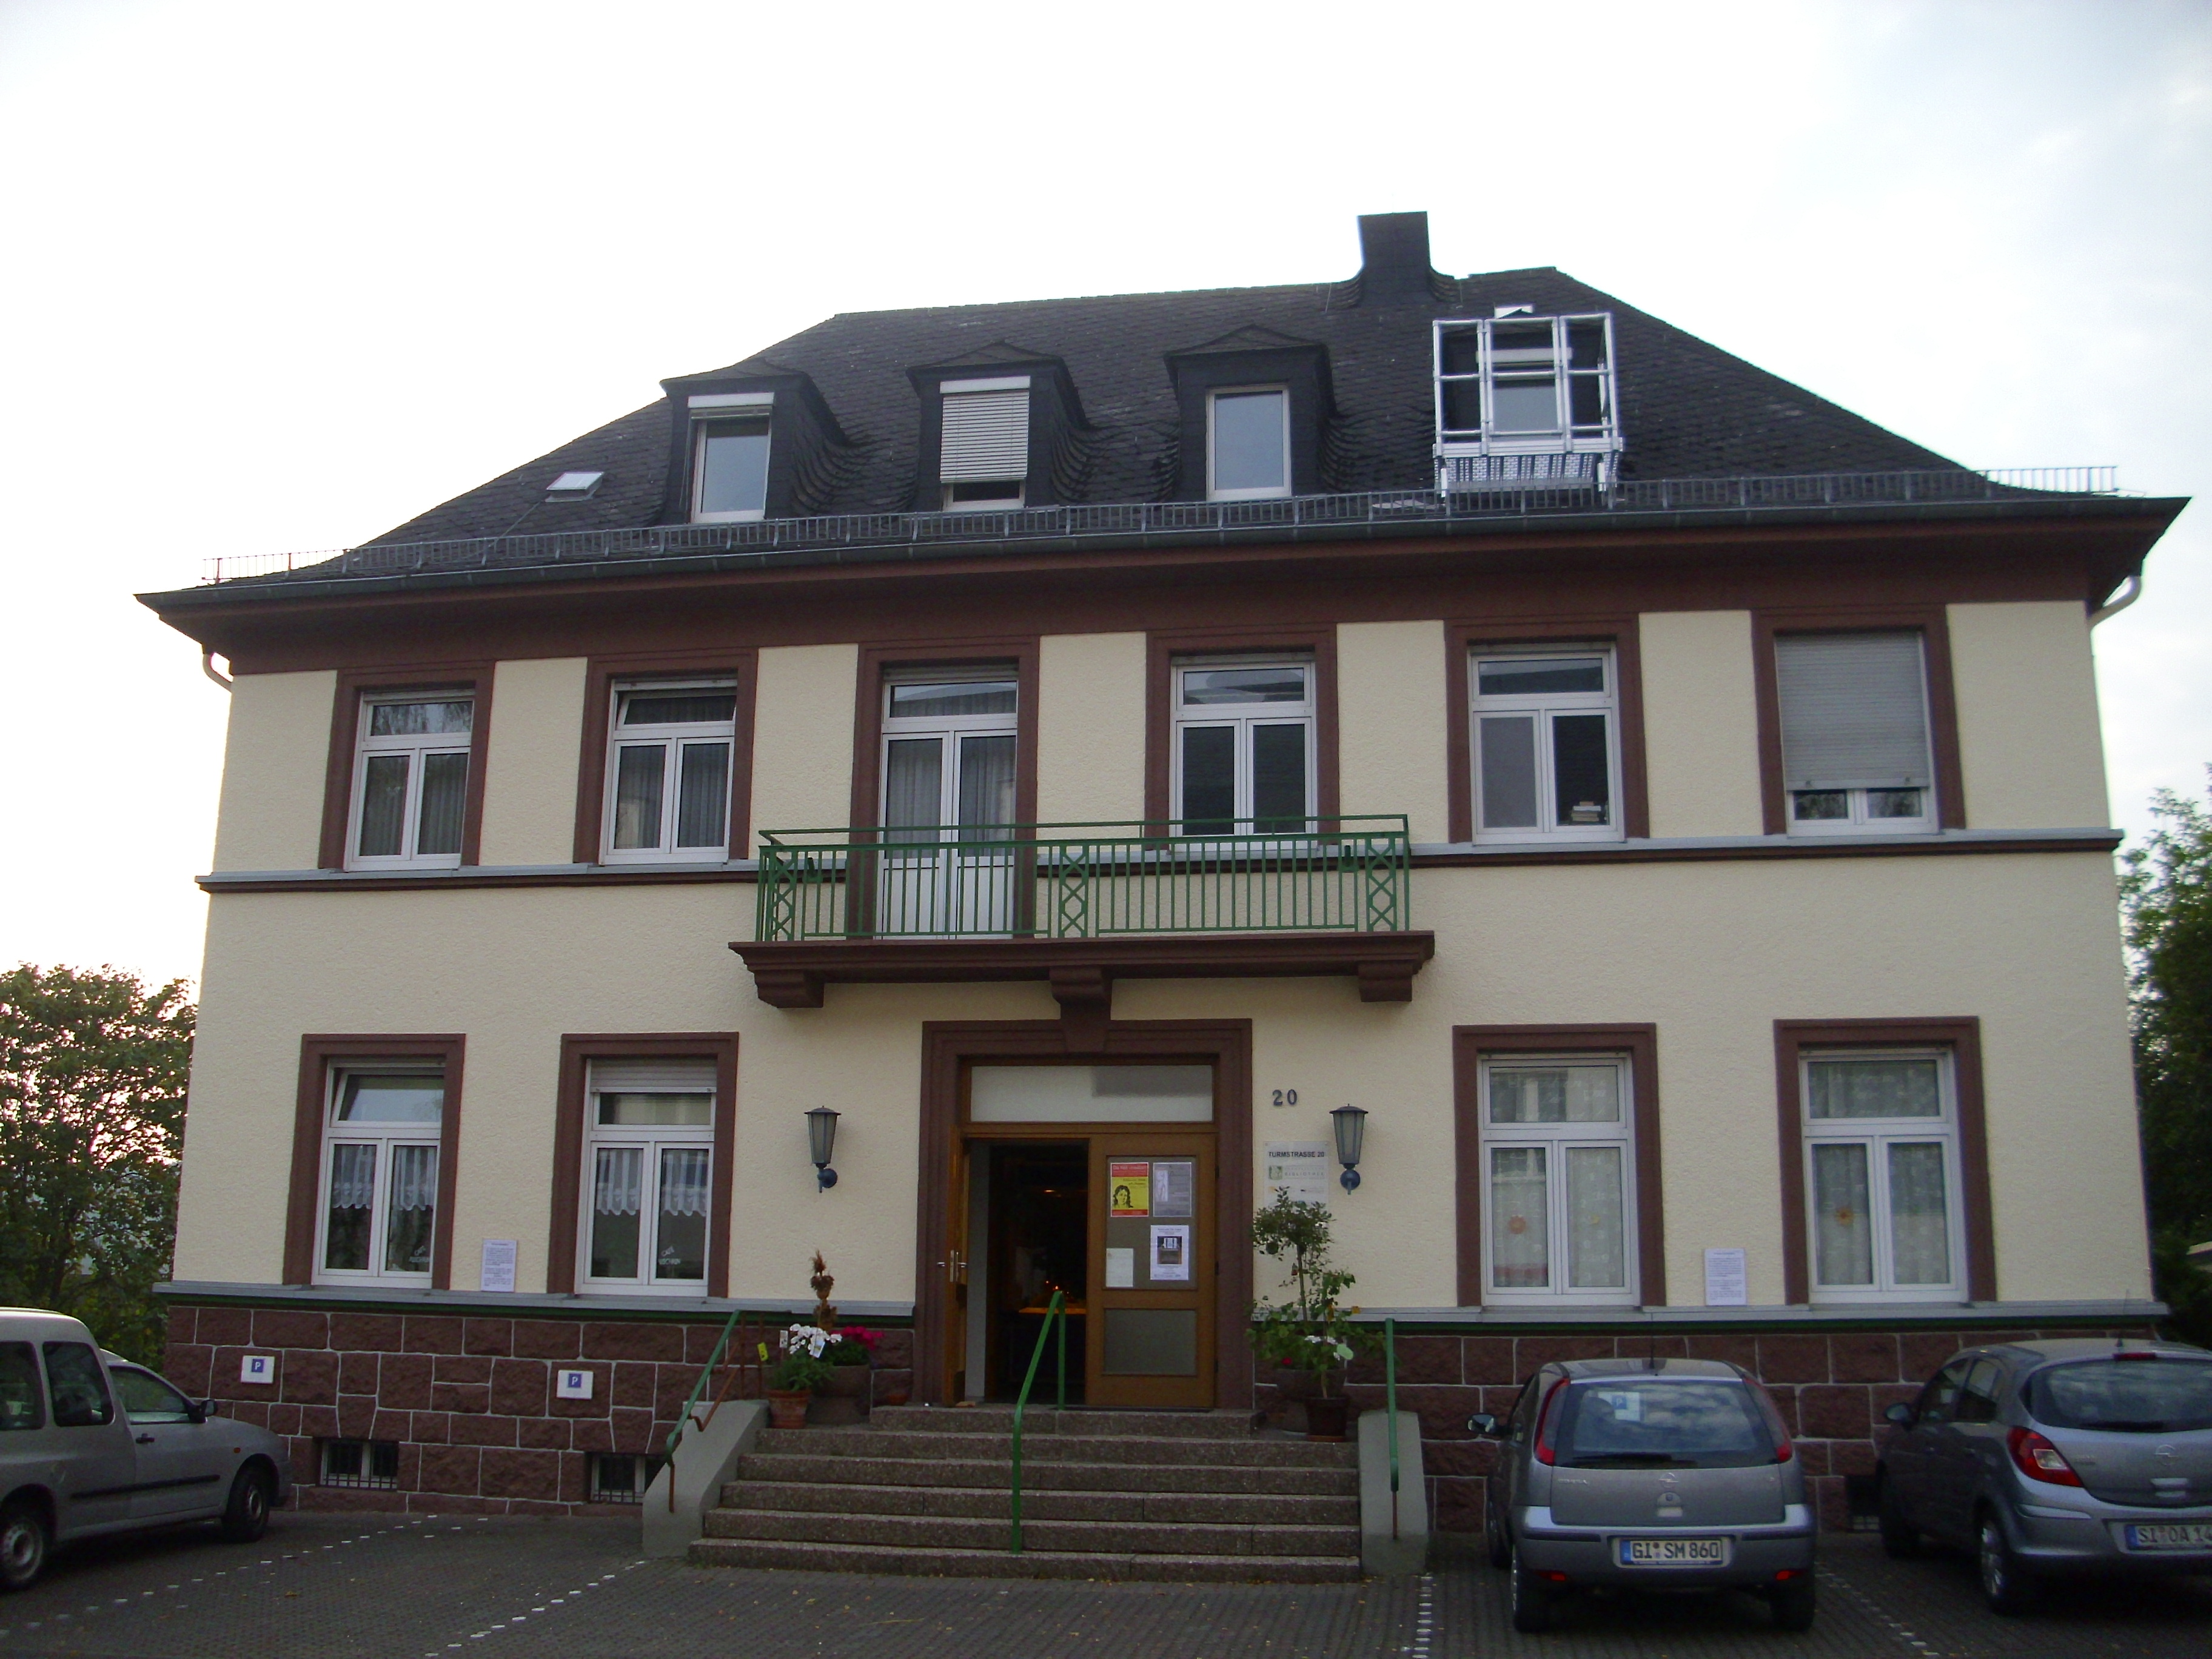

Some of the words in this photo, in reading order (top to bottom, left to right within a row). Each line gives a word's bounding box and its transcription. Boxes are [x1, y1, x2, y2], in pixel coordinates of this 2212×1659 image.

[1272, 1089, 1297, 1106] 20
[572, 1376, 578, 1386] P
[1632, 1542, 1652, 1559] GI
[1664, 1542, 1686, 1558] SM
[1689, 1542, 1718, 1558] 860
